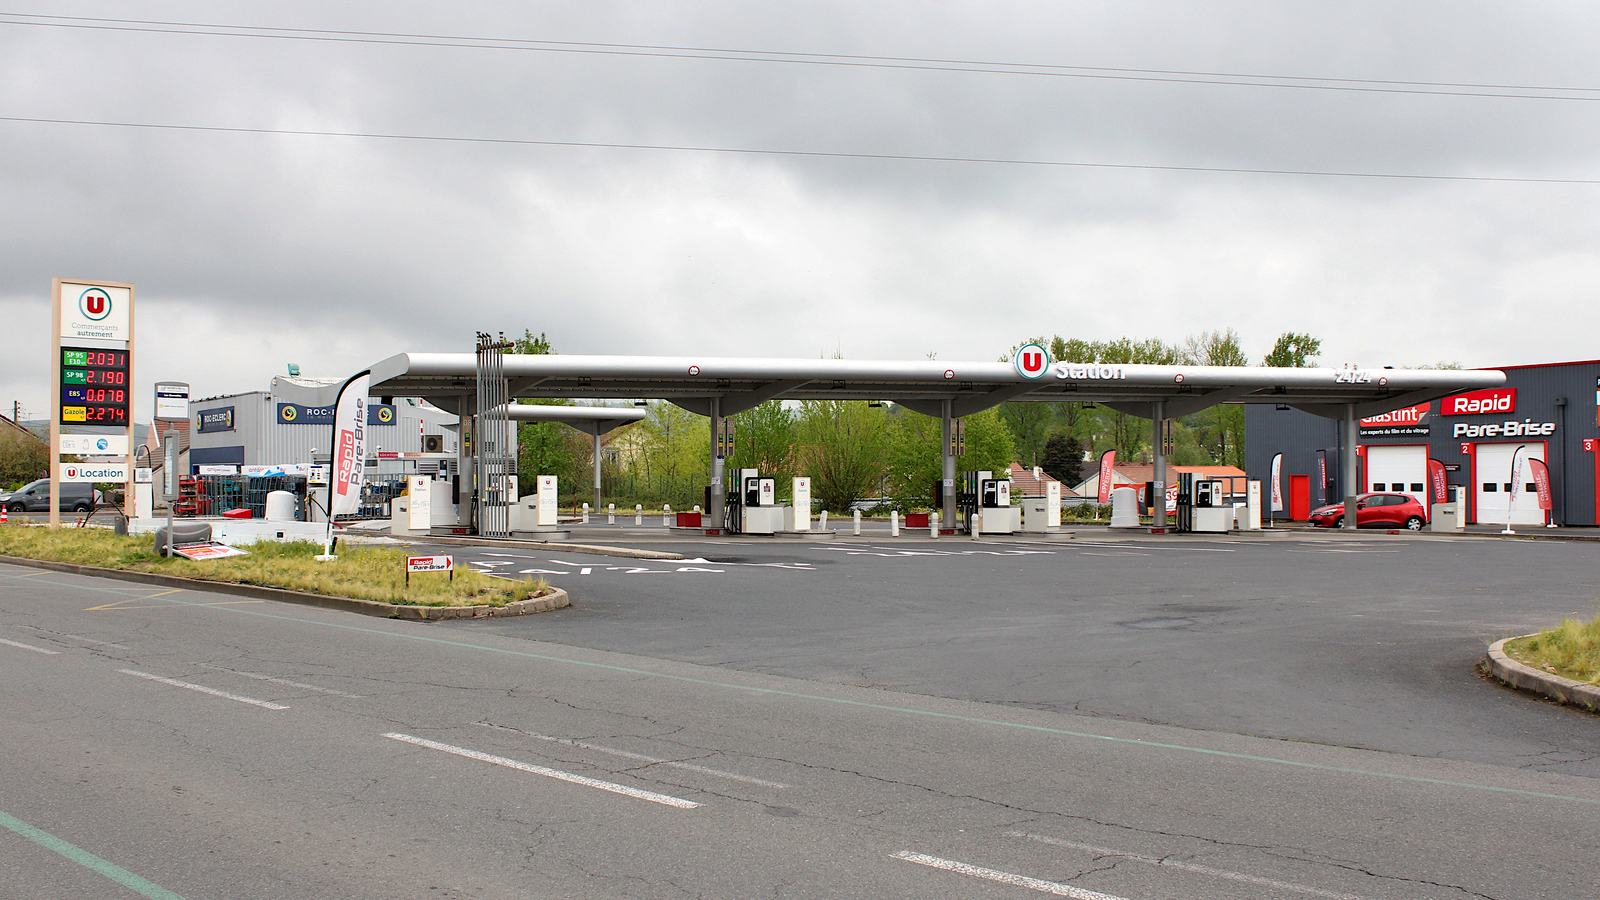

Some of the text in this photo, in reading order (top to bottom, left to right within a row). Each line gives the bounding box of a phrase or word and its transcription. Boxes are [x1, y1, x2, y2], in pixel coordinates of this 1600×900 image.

[86, 296, 104, 314] U
[77, 330, 113, 338] autrement
[86, 352, 124, 366] 2.031
[1023, 353, 1041, 372] U
[86, 370, 124, 384] 2.190
[1056, 362, 1126, 379] Station
[1334, 372, 1371, 384] 24/24
[86, 389, 124, 402] 0.878
[1454, 394, 1511, 414] Rapid
[86, 408, 124, 420] 2.274
[1453, 418, 1556, 438] Pare-Brise
[350, 398, 364, 485] Pare-Brise
[1585, 442, 1591, 450] 3
[340, 433, 353, 483] Rapid
[68, 468, 123, 478] U Location
